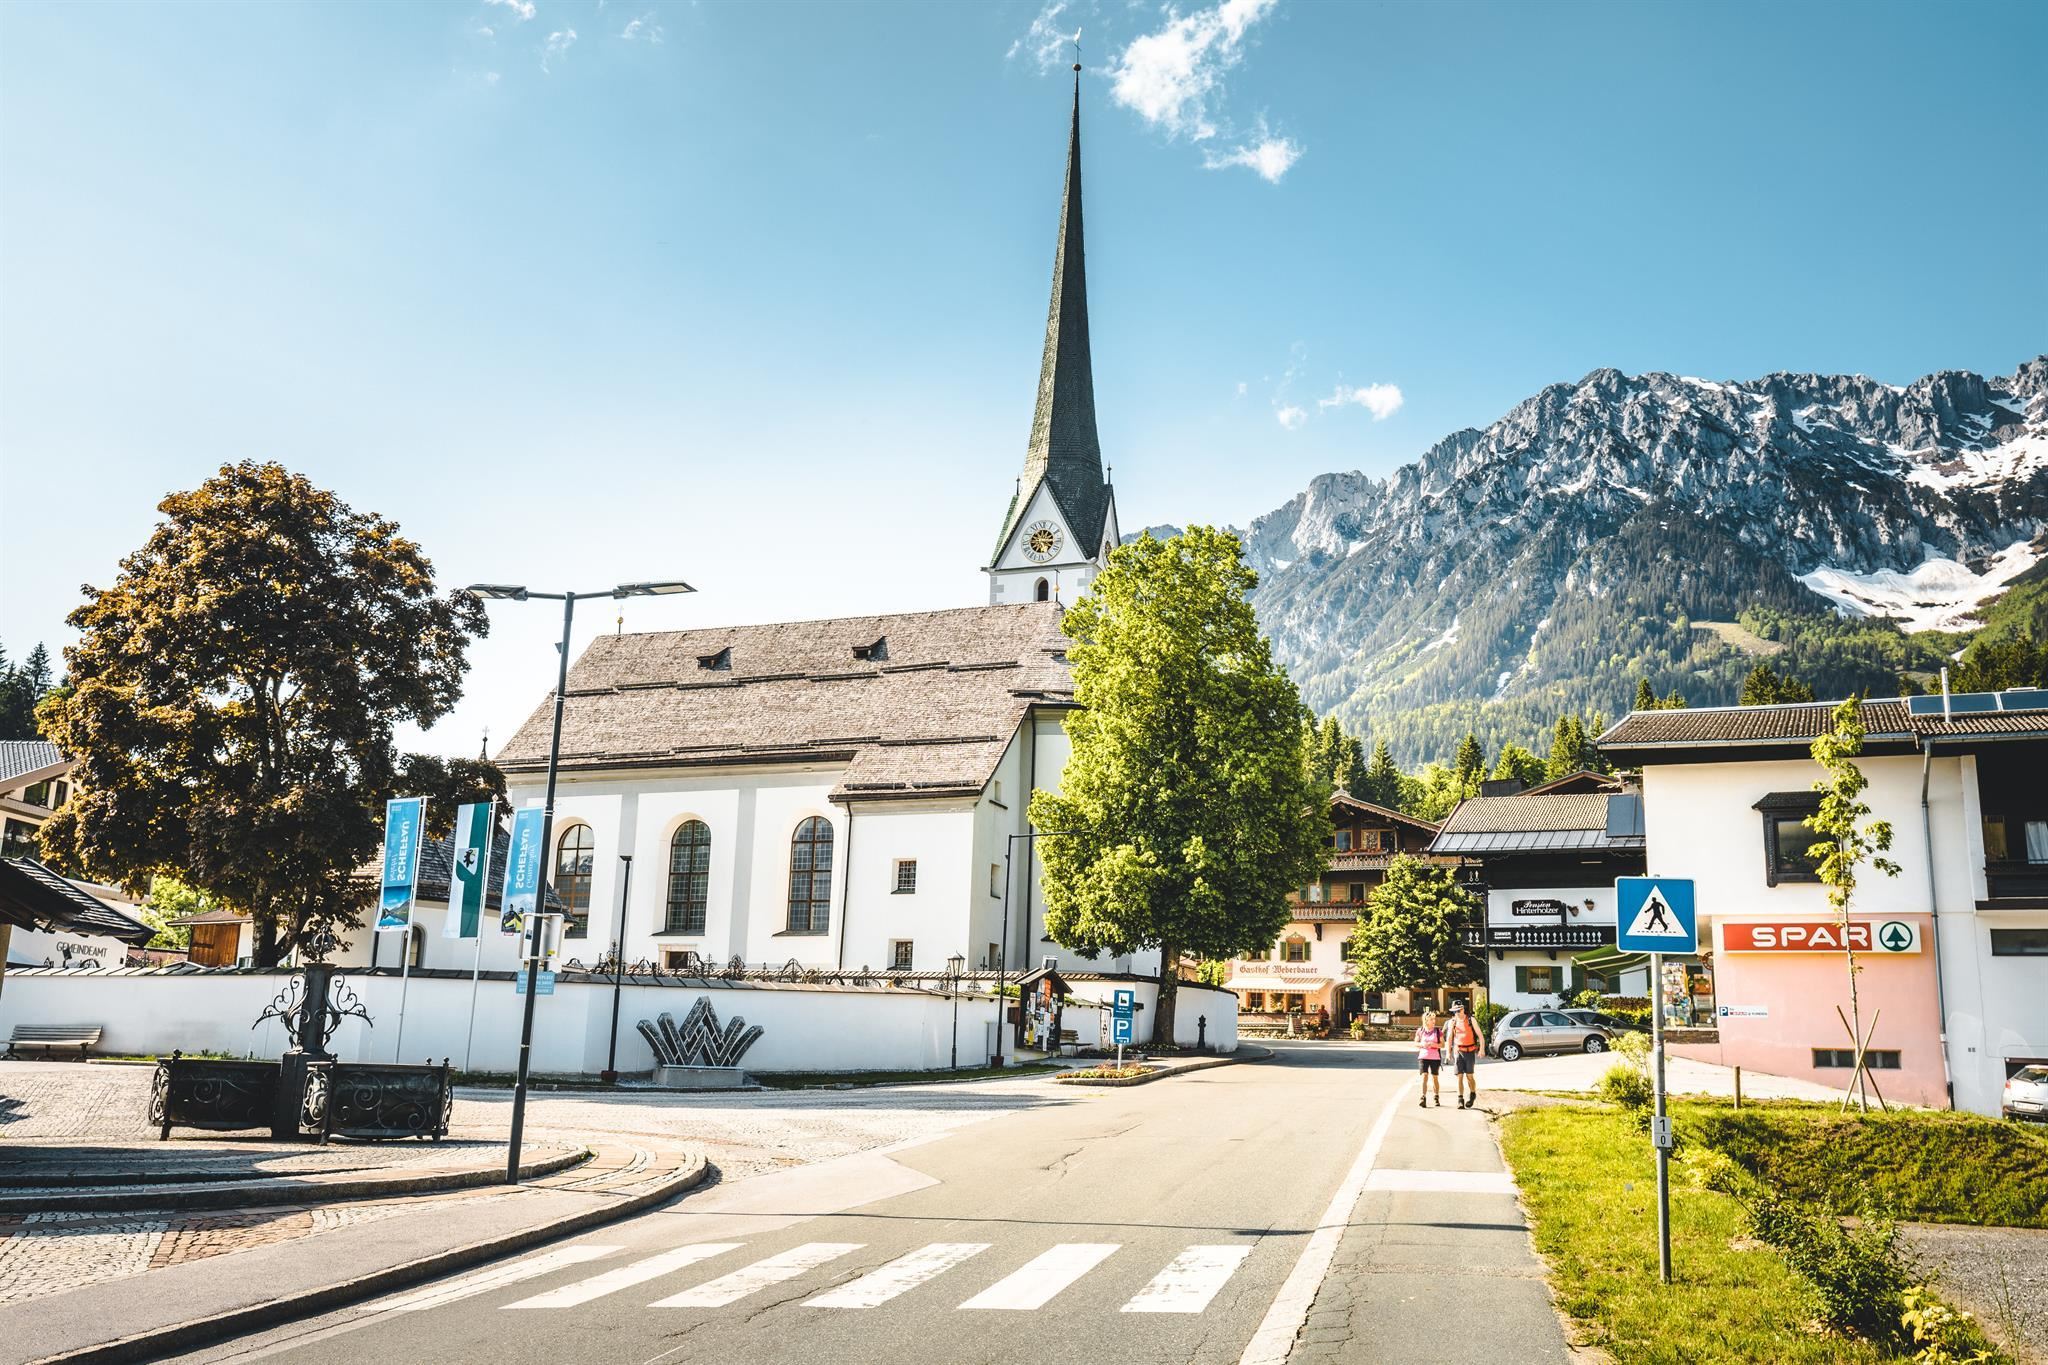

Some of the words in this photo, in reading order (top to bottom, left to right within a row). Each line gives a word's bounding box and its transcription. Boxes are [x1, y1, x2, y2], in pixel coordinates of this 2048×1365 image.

[1516, 906, 1559, 914] Hinterholzer
[1751, 926, 1868, 948] SPAR
[56, 941, 108, 958] GEMEINDEAMT
[1239, 964, 1270, 975] Gasthof
[1272, 964, 1318, 975] Weberbauer
[1116, 1020, 1129, 1036] P
[1659, 1119, 1666, 1132] 1
